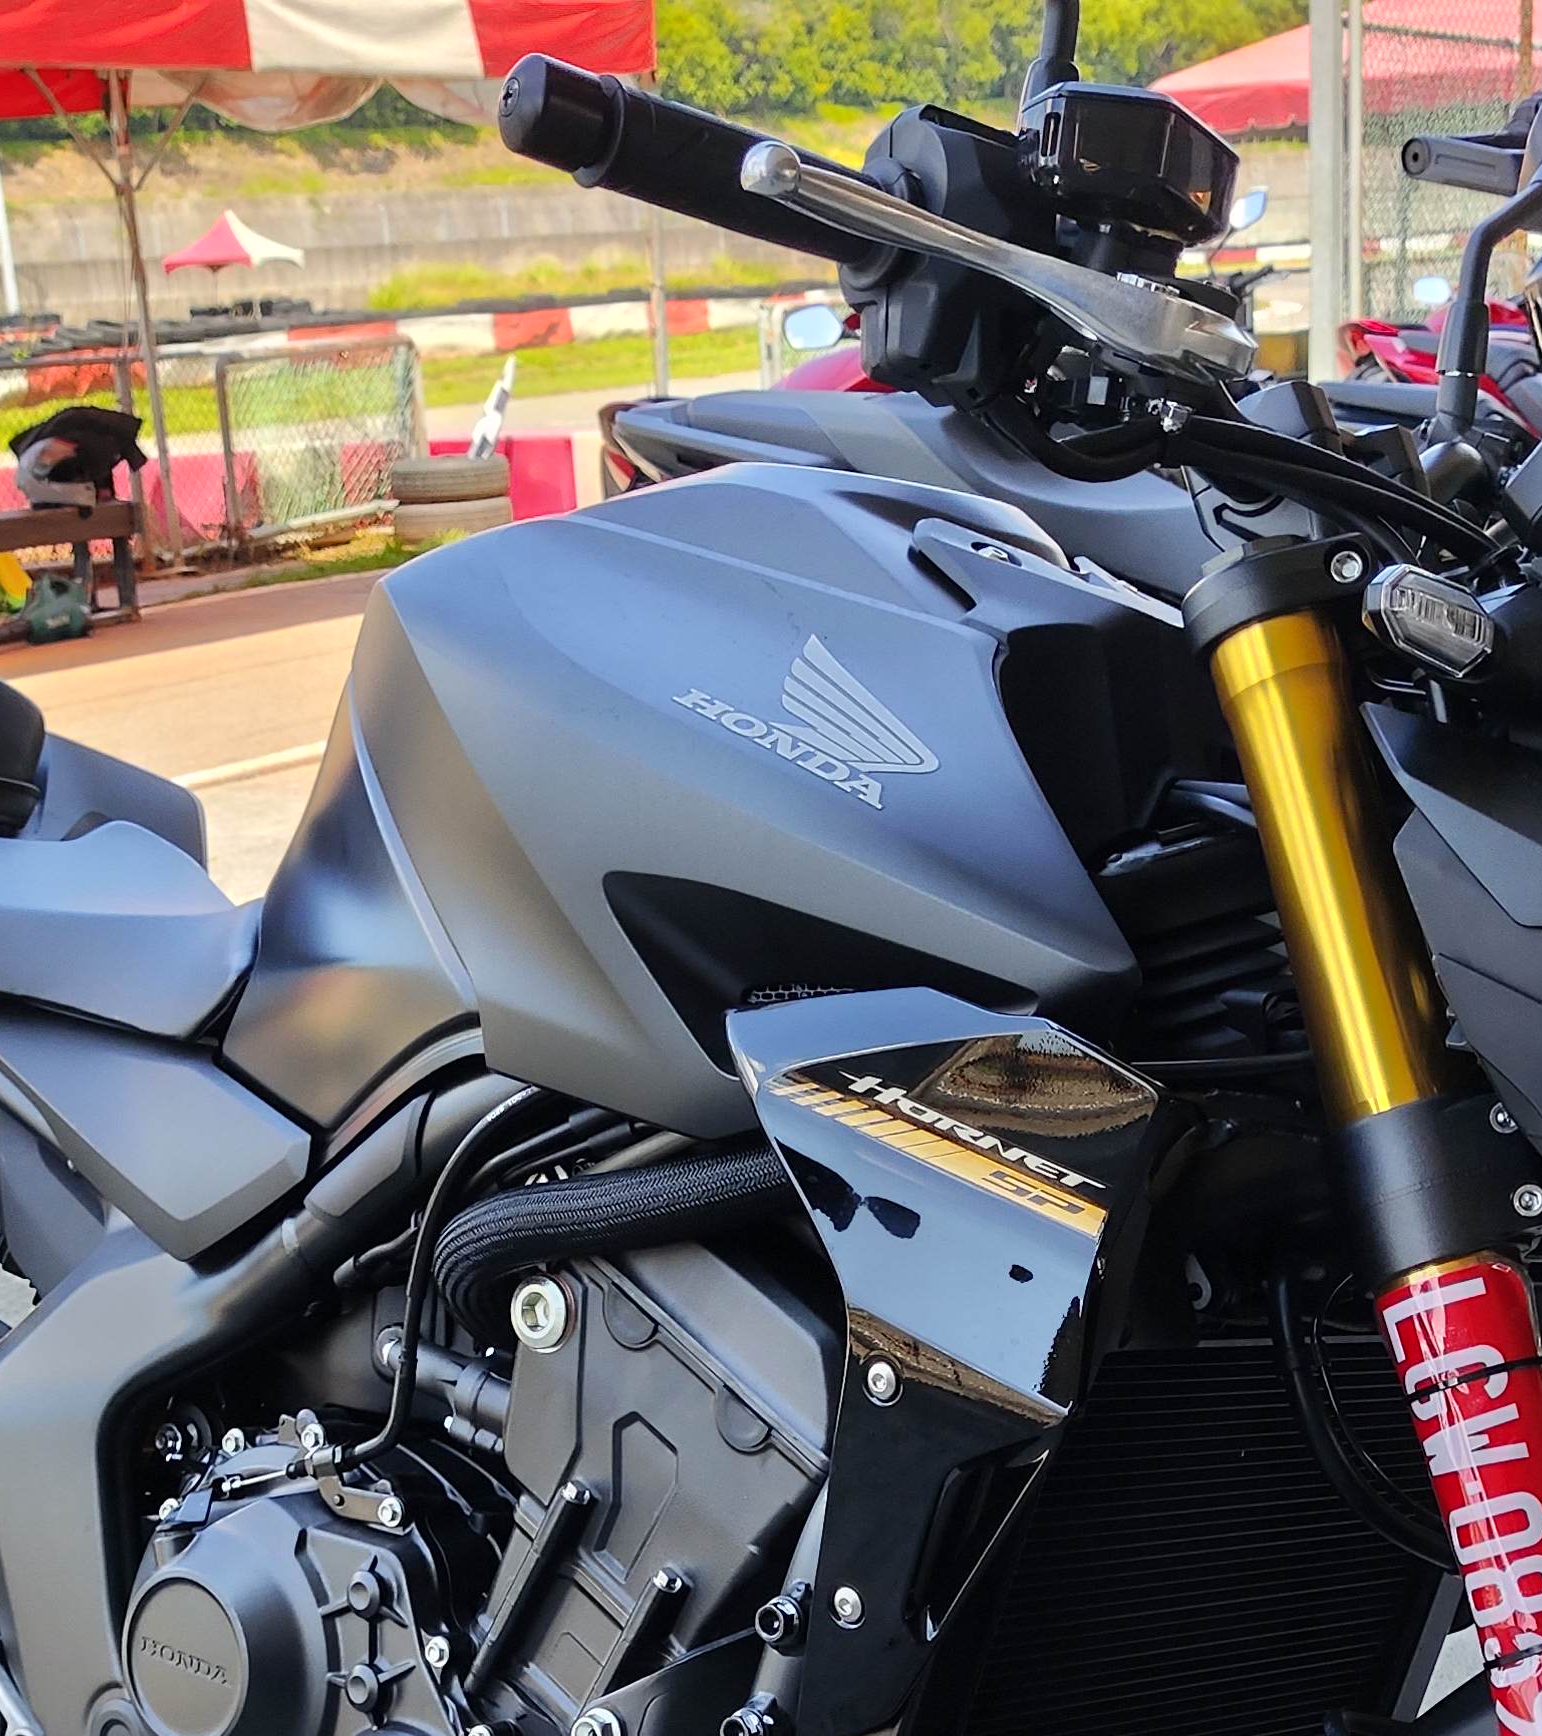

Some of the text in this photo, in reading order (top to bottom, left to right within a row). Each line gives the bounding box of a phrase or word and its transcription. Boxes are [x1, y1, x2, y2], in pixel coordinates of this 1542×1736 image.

[671, 687, 884, 810] HONDA
[837, 1069, 1107, 1189] HORNET
[981, 1169, 1085, 1215] SP
[139, 1635, 232, 1687] HONDA
